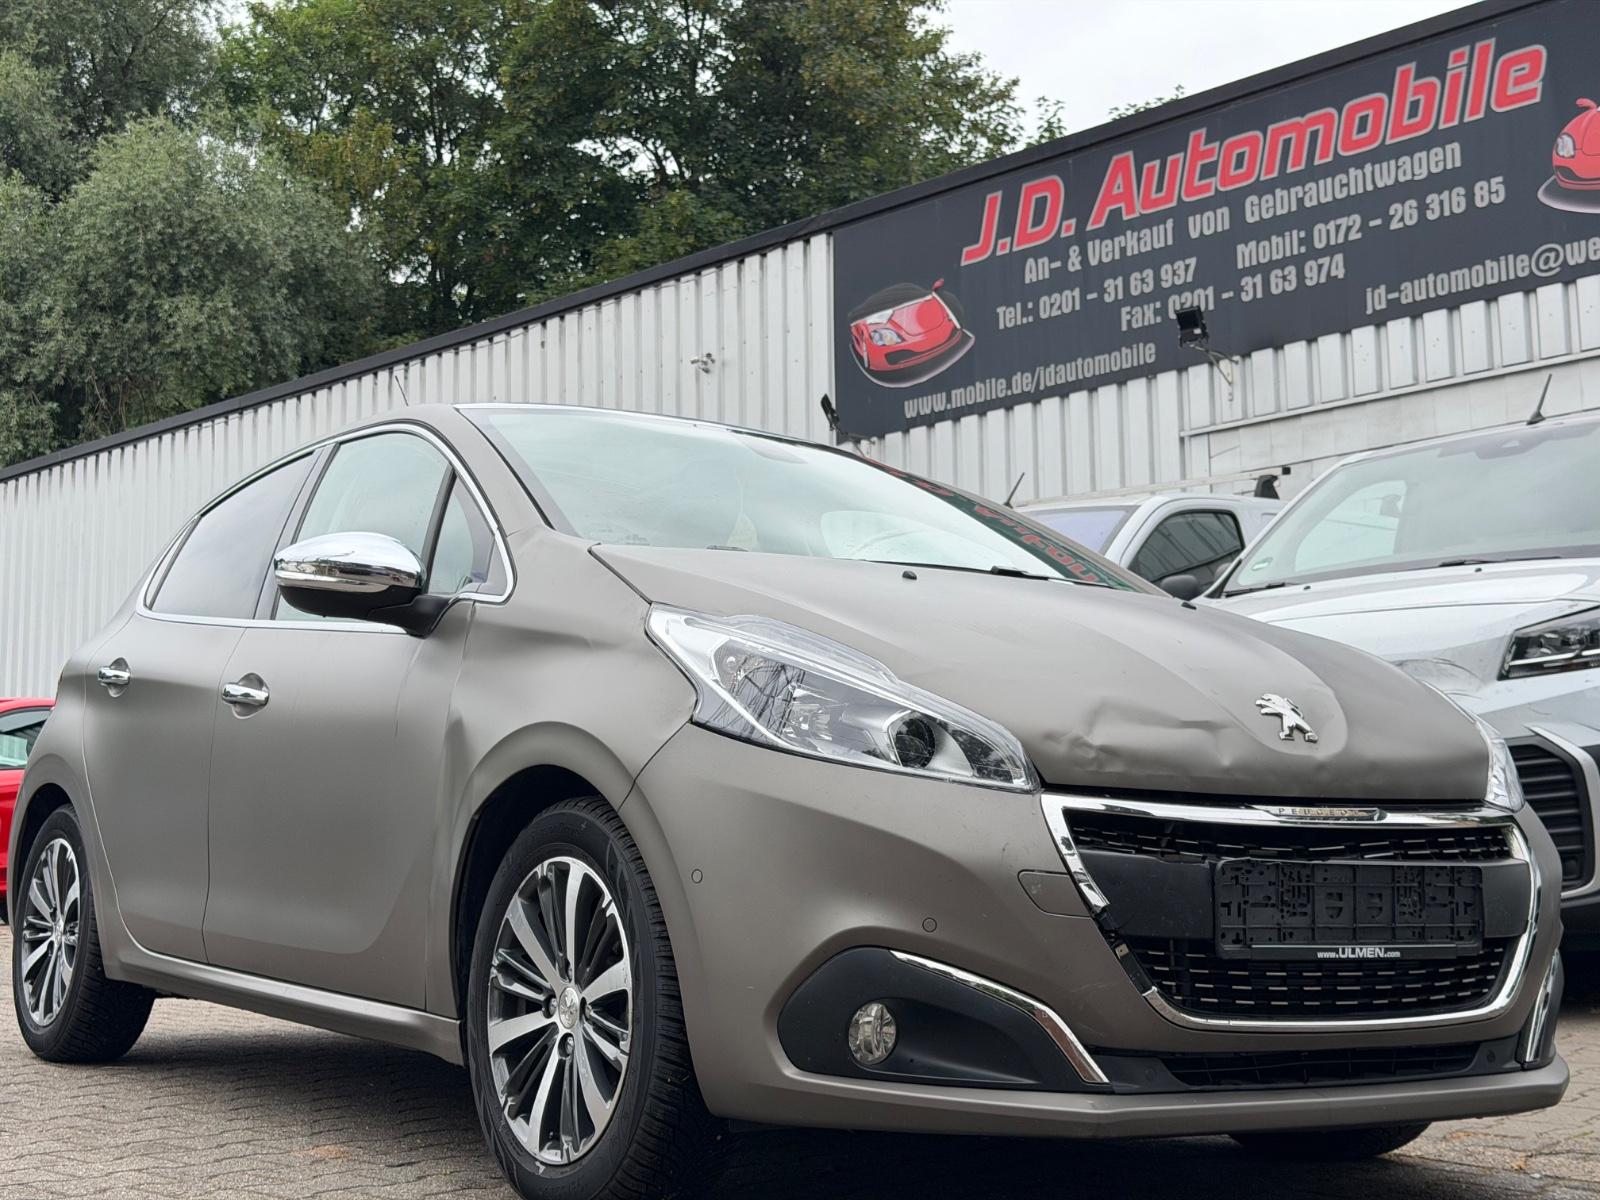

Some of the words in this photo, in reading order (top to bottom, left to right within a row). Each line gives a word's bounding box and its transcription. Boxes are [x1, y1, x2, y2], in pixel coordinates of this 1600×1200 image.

[961, 175, 1077, 267] J.D.
[1086, 38, 1547, 231] Automobile
[1024, 257, 1062, 285] An-
[1067, 245, 1082, 273] &
[1088, 218, 1175, 267] Verkauf
[1188, 206, 1230, 240] von
[1244, 141, 1462, 224] Gebrauchtwagen
[1236, 229, 1307, 270] Mobil:
[1313, 213, 1362, 250] 0172
[1389, 199, 1418, 231] 26
[1425, 185, 1467, 221] 316
[1473, 176, 1506, 209] 85
[997, 303, 1034, 330] Tel.:
[1039, 288, 1081, 321] 0201
[1103, 276, 1124, 303] 31
[1129, 269, 1154, 296] 63
[1160, 257, 1197, 289] 937
[1121, 301, 1162, 331] Fax:
[1240, 273, 1263, 302] 31
[1269, 265, 1297, 295] 63
[1304, 253, 1346, 288] 974
[903, 342, 1157, 419] www.mobile.de/jdautomobile
[1317, 946, 1401, 959] www.ULMEN.com
